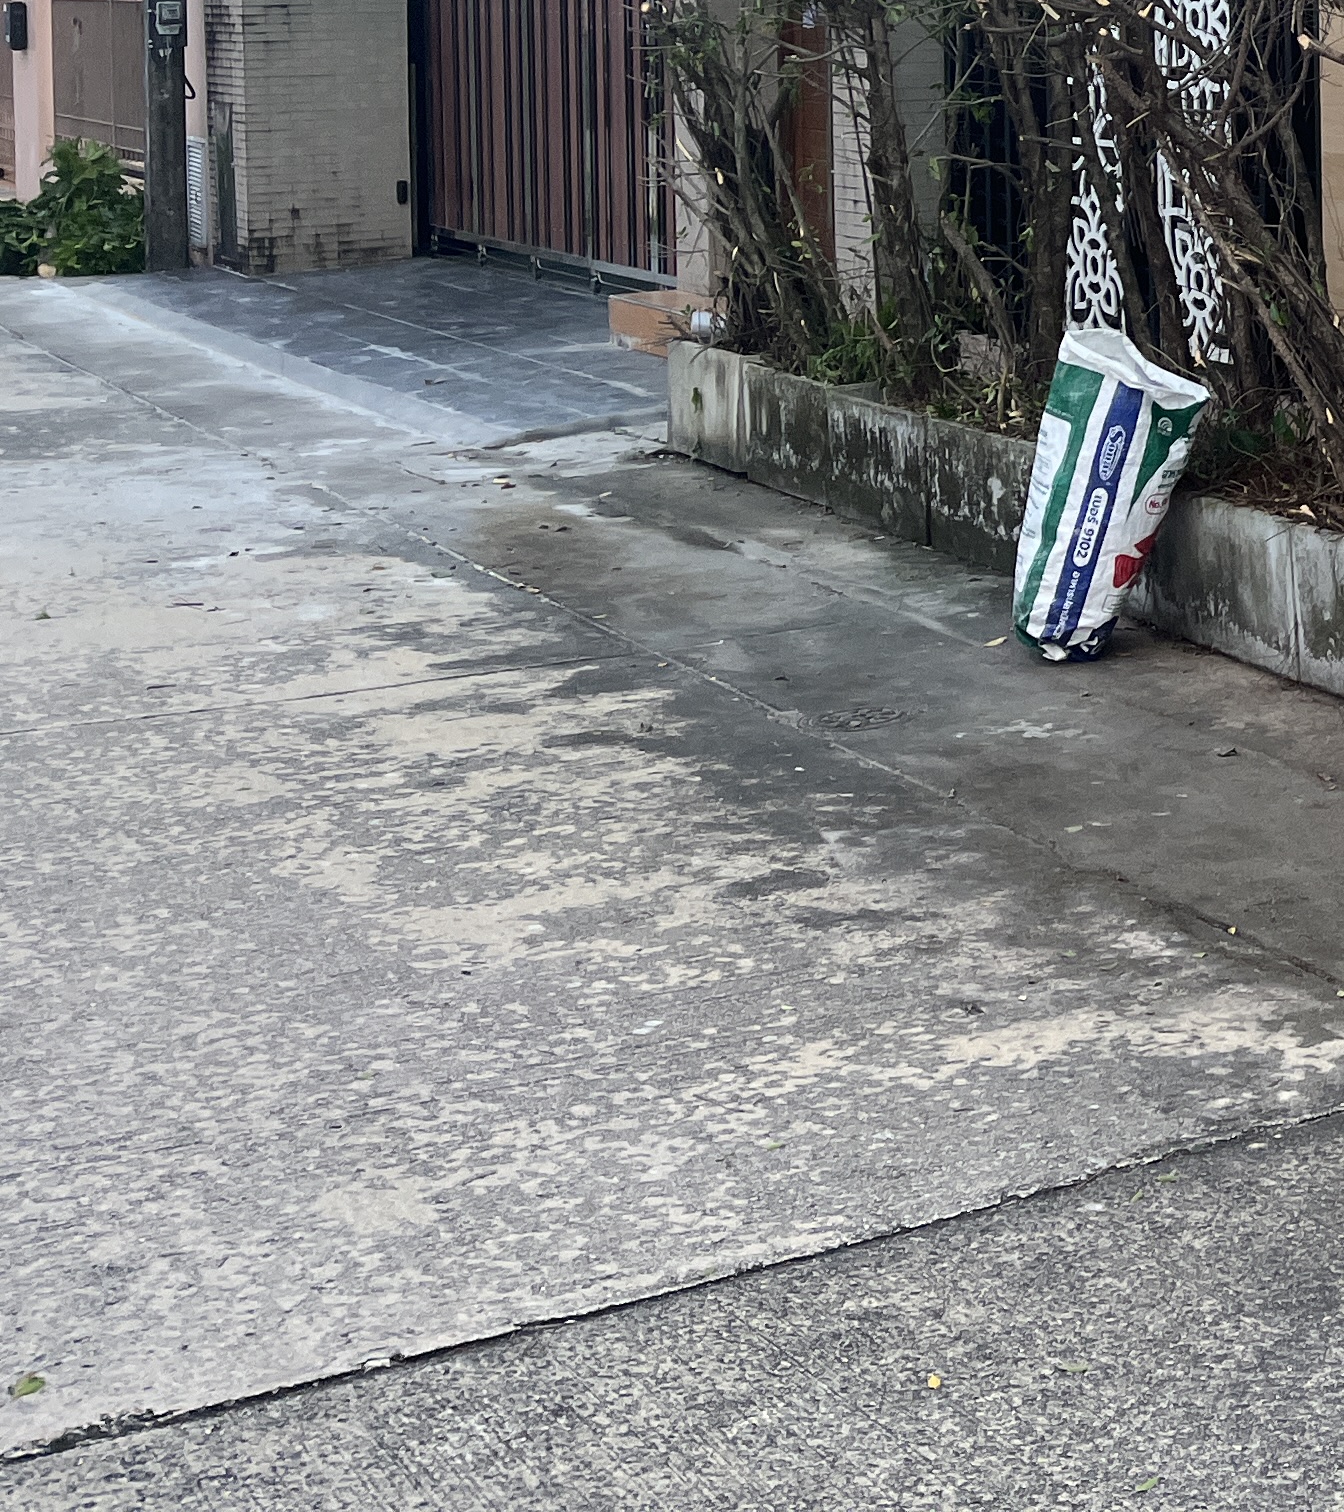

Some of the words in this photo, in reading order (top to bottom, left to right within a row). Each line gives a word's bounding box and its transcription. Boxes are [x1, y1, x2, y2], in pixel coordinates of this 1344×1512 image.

[1101, 429, 1124, 476] Sonar
[1087, 494, 1103, 526] เบอร์
[1076, 527, 1095, 559] 9102
